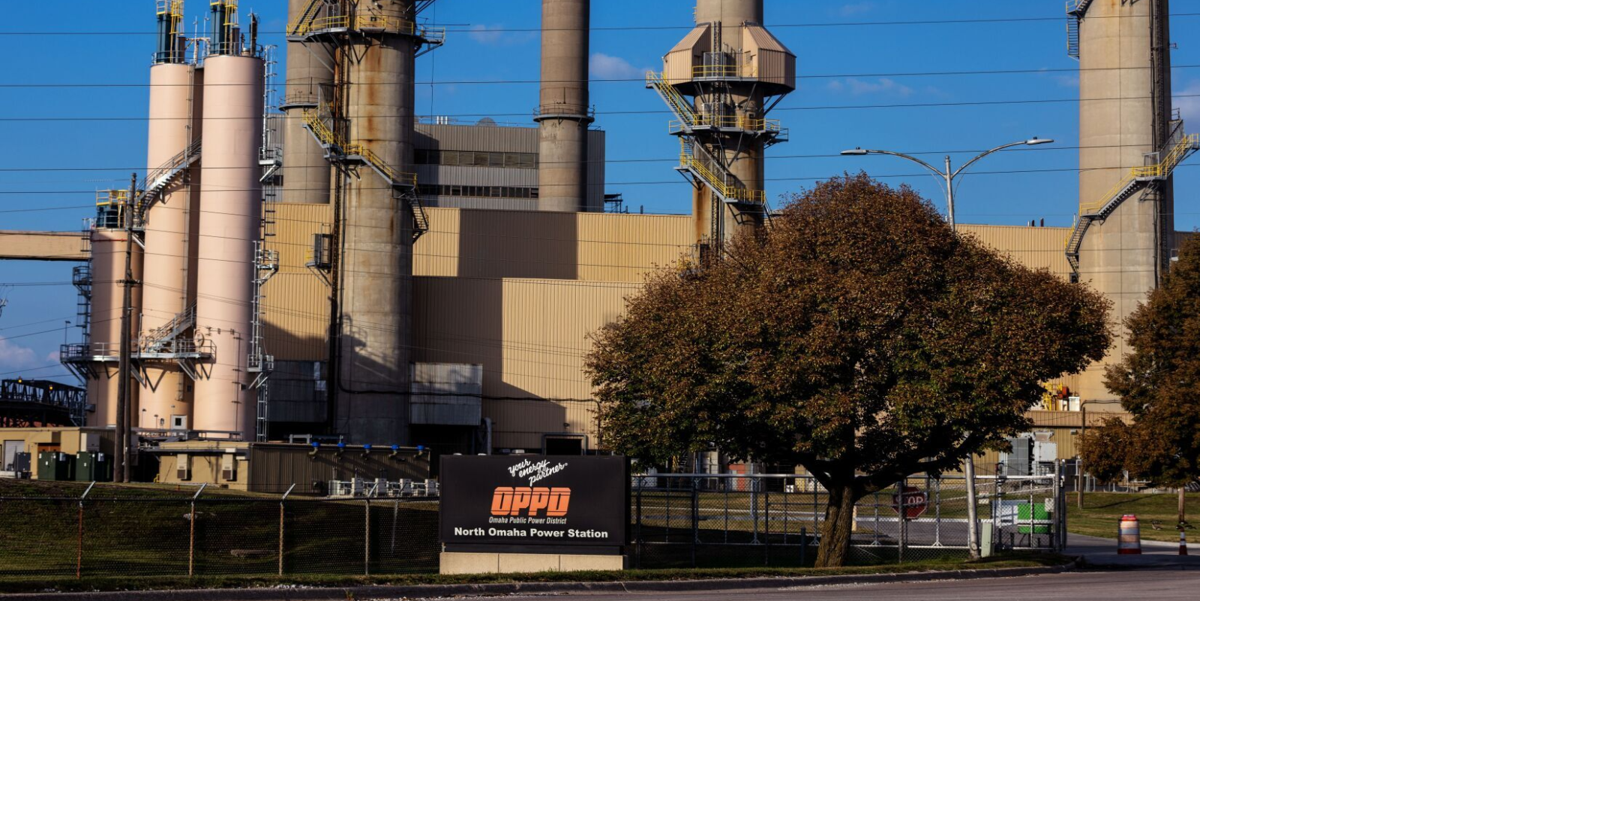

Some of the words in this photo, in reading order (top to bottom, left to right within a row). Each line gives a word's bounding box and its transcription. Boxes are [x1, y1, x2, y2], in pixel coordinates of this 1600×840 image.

[508, 458, 531, 477] your
[518, 459, 551, 478] energy
[490, 486, 572, 516] OPPD
[489, 516, 508, 525] Omaha
[509, 516, 527, 525] Public
[528, 517, 546, 525] Power
[546, 517, 567, 525] District
[454, 527, 485, 536] North
[488, 527, 527, 537] Omaha
[530, 528, 565, 537] Power
[567, 528, 609, 538] Station
